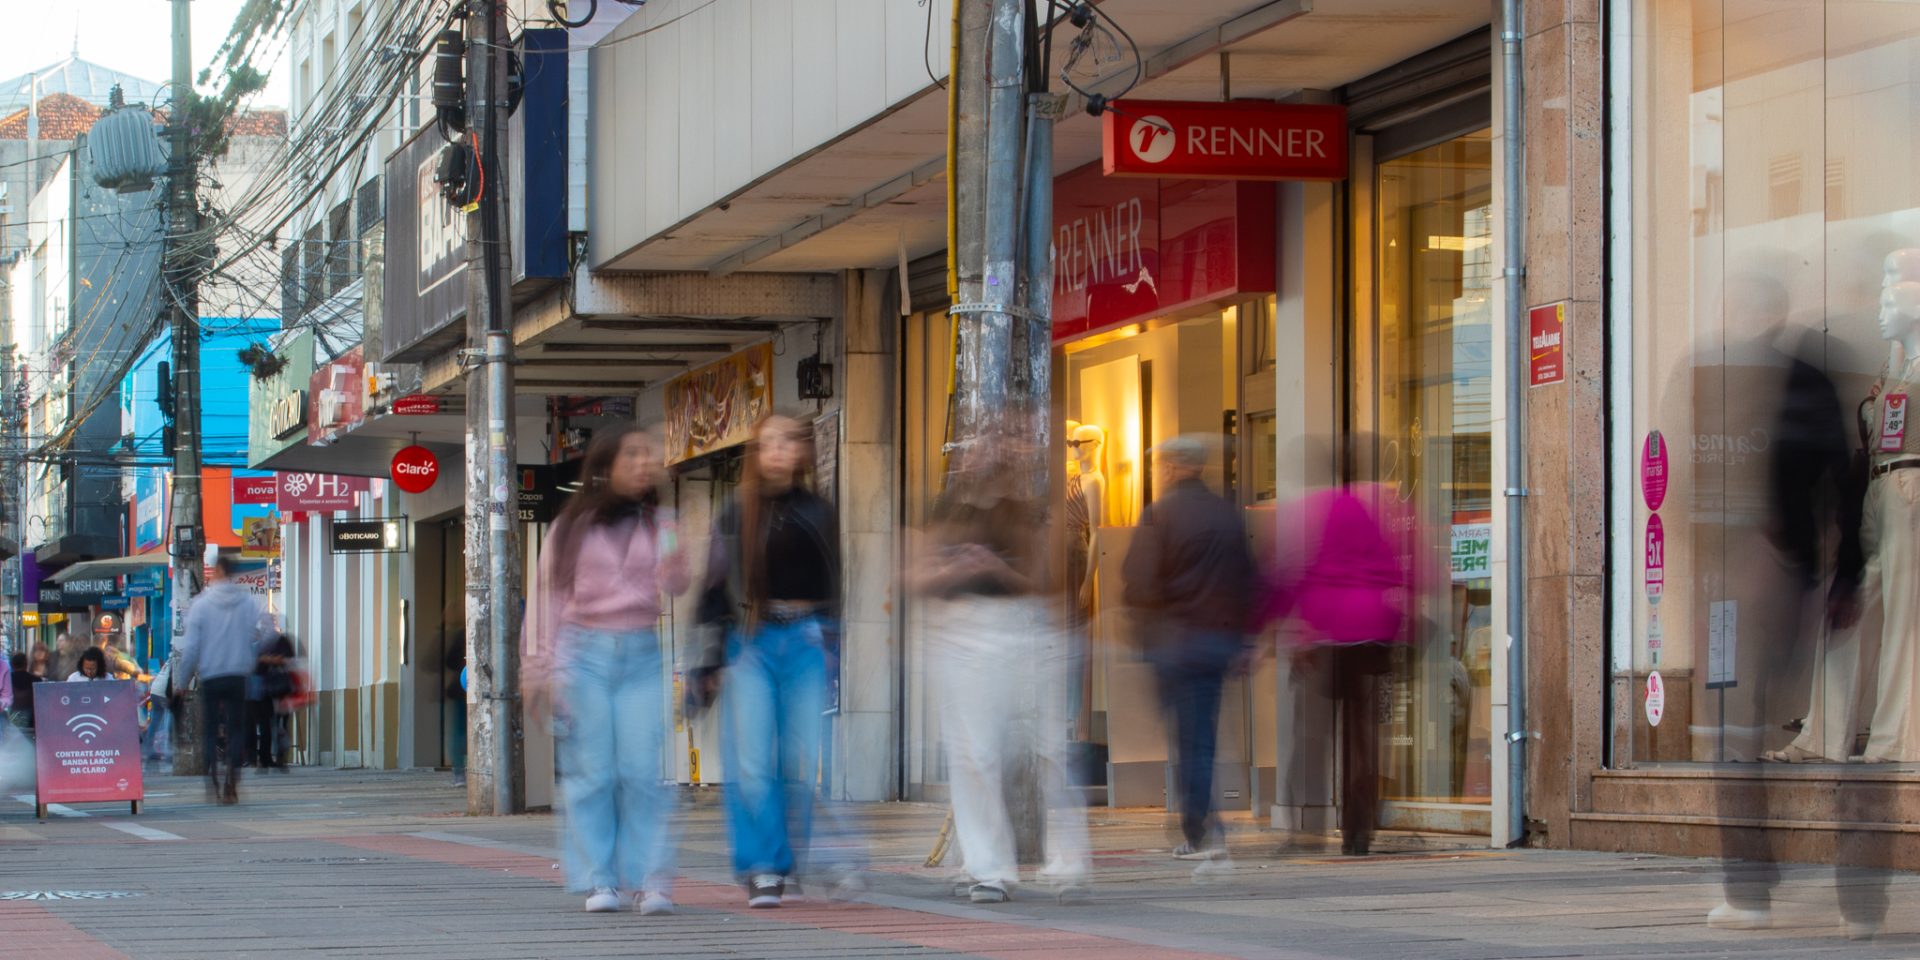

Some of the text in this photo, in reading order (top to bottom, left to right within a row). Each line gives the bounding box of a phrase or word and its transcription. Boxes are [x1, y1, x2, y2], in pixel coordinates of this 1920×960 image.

[1187, 125, 1326, 158] RENNER
[1060, 198, 1143, 296] RENNER
[396, 463, 429, 476] Claro
[1648, 532, 1661, 566] 5x
[64, 580, 113, 591] FINISH LINE
